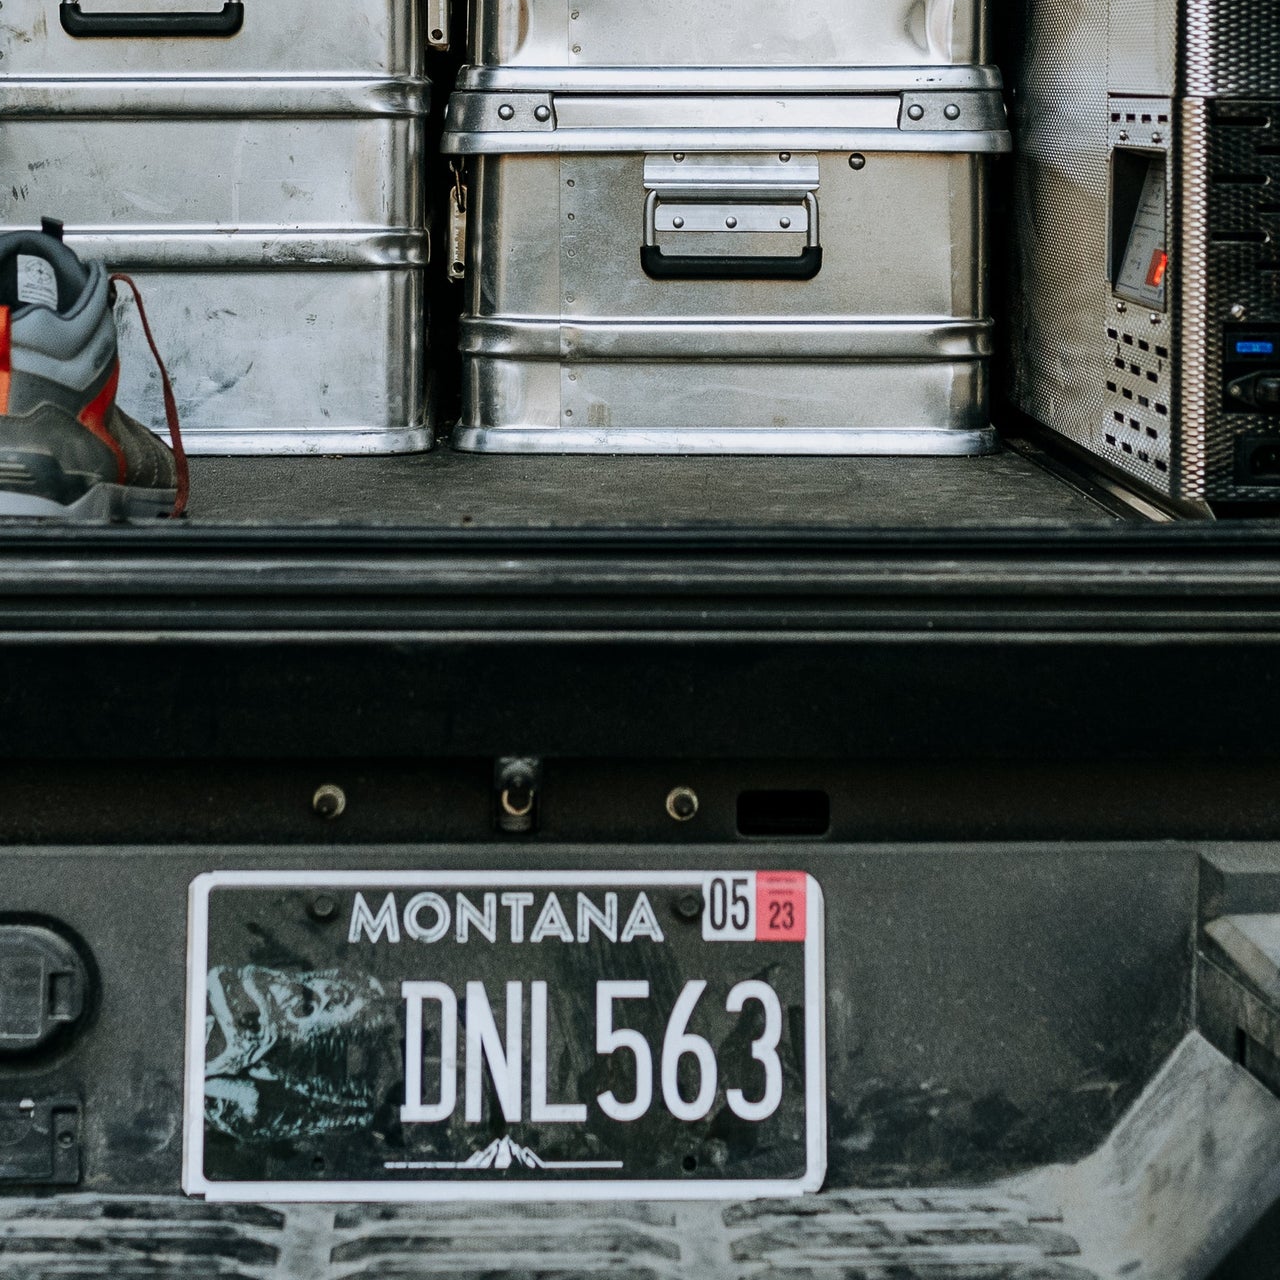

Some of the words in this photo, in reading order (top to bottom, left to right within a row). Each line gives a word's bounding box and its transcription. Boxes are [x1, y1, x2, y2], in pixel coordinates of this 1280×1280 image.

[348, 891, 665, 944] MONTANA
[710, 878, 749, 930] 05
[768, 901, 795, 930] 23
